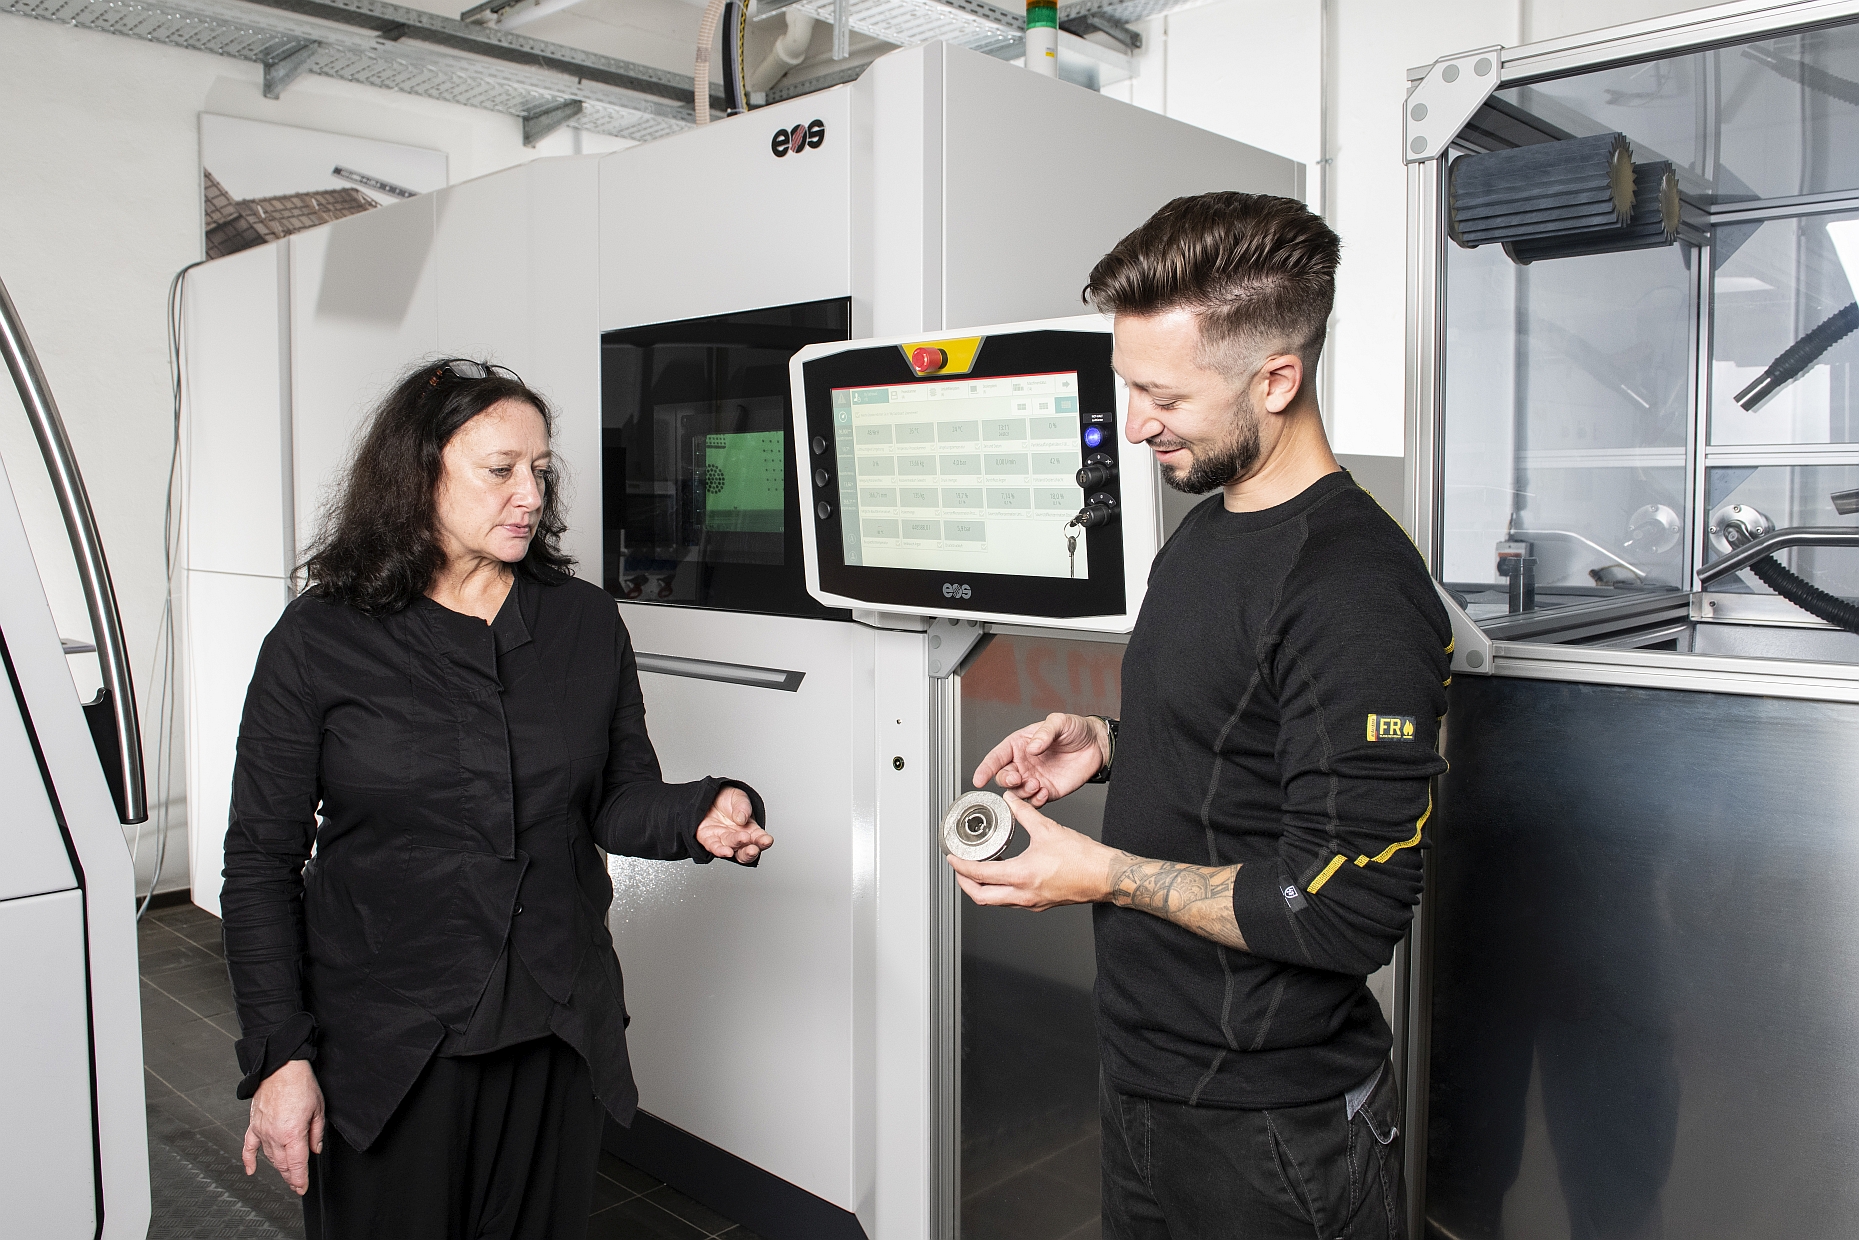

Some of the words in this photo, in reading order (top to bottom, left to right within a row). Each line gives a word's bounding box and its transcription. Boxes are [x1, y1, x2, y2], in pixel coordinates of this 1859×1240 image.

[771, 118, 826, 158] eos
[942, 582, 972, 600] eos
[1380, 718, 1402, 735] FR
